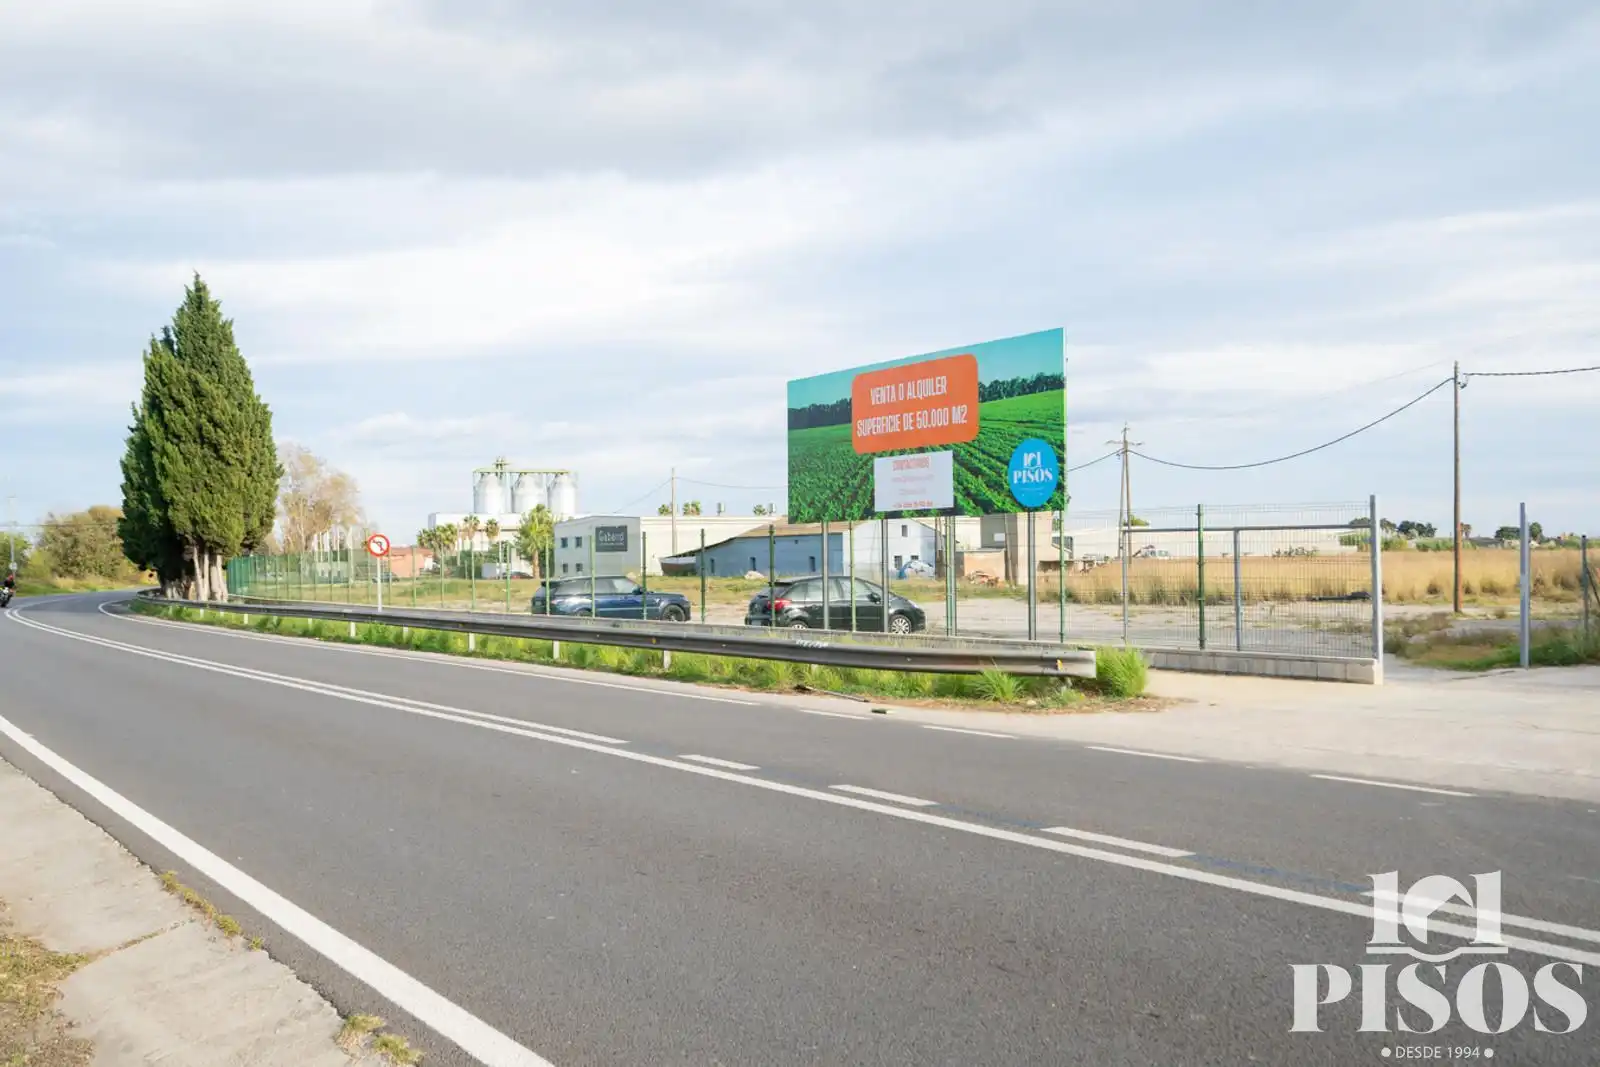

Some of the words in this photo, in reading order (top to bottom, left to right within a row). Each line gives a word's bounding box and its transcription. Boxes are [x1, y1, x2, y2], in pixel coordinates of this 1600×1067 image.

[870, 384, 897, 405] VENTA
[898, 383, 905, 401] O
[906, 375, 948, 400] ALQUILER
[856, 413, 901, 437] SUPERFICIE
[902, 412, 915, 432] DE
[916, 407, 949, 430] 50.000
[951, 404, 968, 425] M2
[1013, 468, 1053, 484] PISOS
